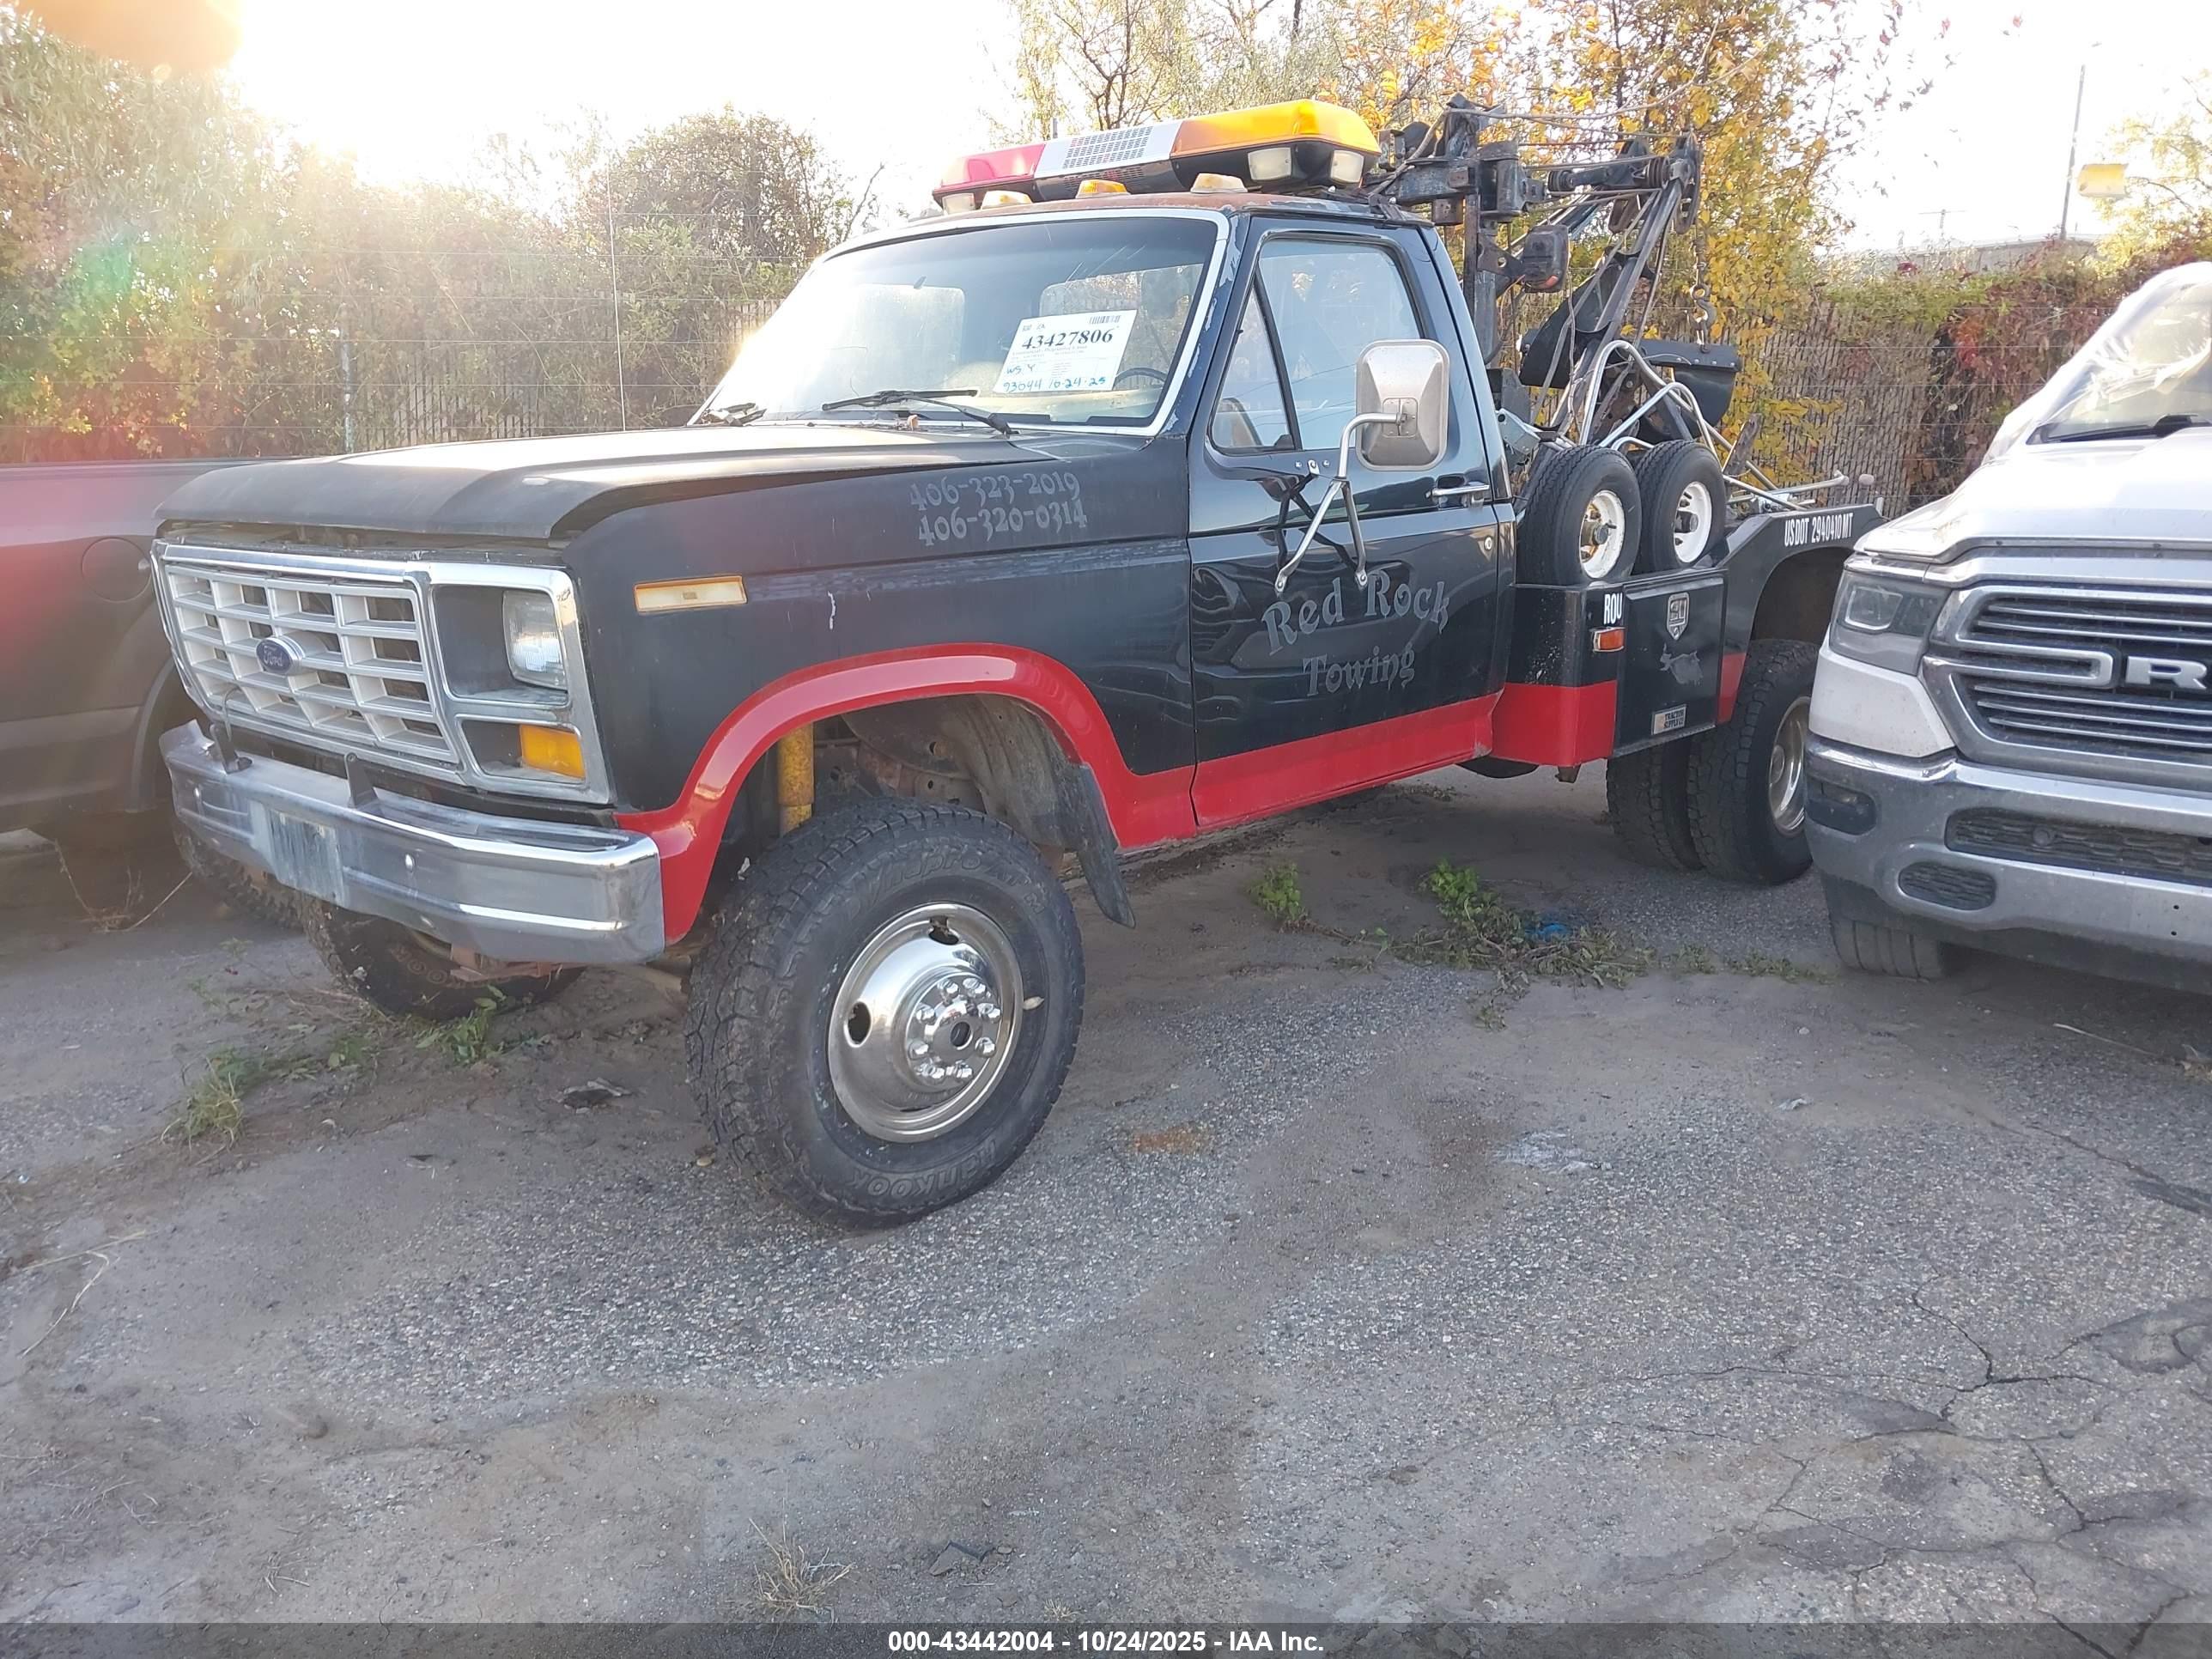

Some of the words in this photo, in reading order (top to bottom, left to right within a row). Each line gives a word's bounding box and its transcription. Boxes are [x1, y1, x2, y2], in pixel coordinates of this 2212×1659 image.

[1022, 328, 1114, 349] 43427806
[910, 471, 1080, 511] 406-323-2019
[919, 498, 1087, 546] 406-320-0314
[1784, 518, 1809, 547] USDOT
[1261, 577, 1346, 656] Red
[1364, 569, 1449, 635] Rock
[1604, 592, 1622, 624] ROU
[263, 645, 284, 667] Ford
[1303, 641, 1415, 697] Towing
